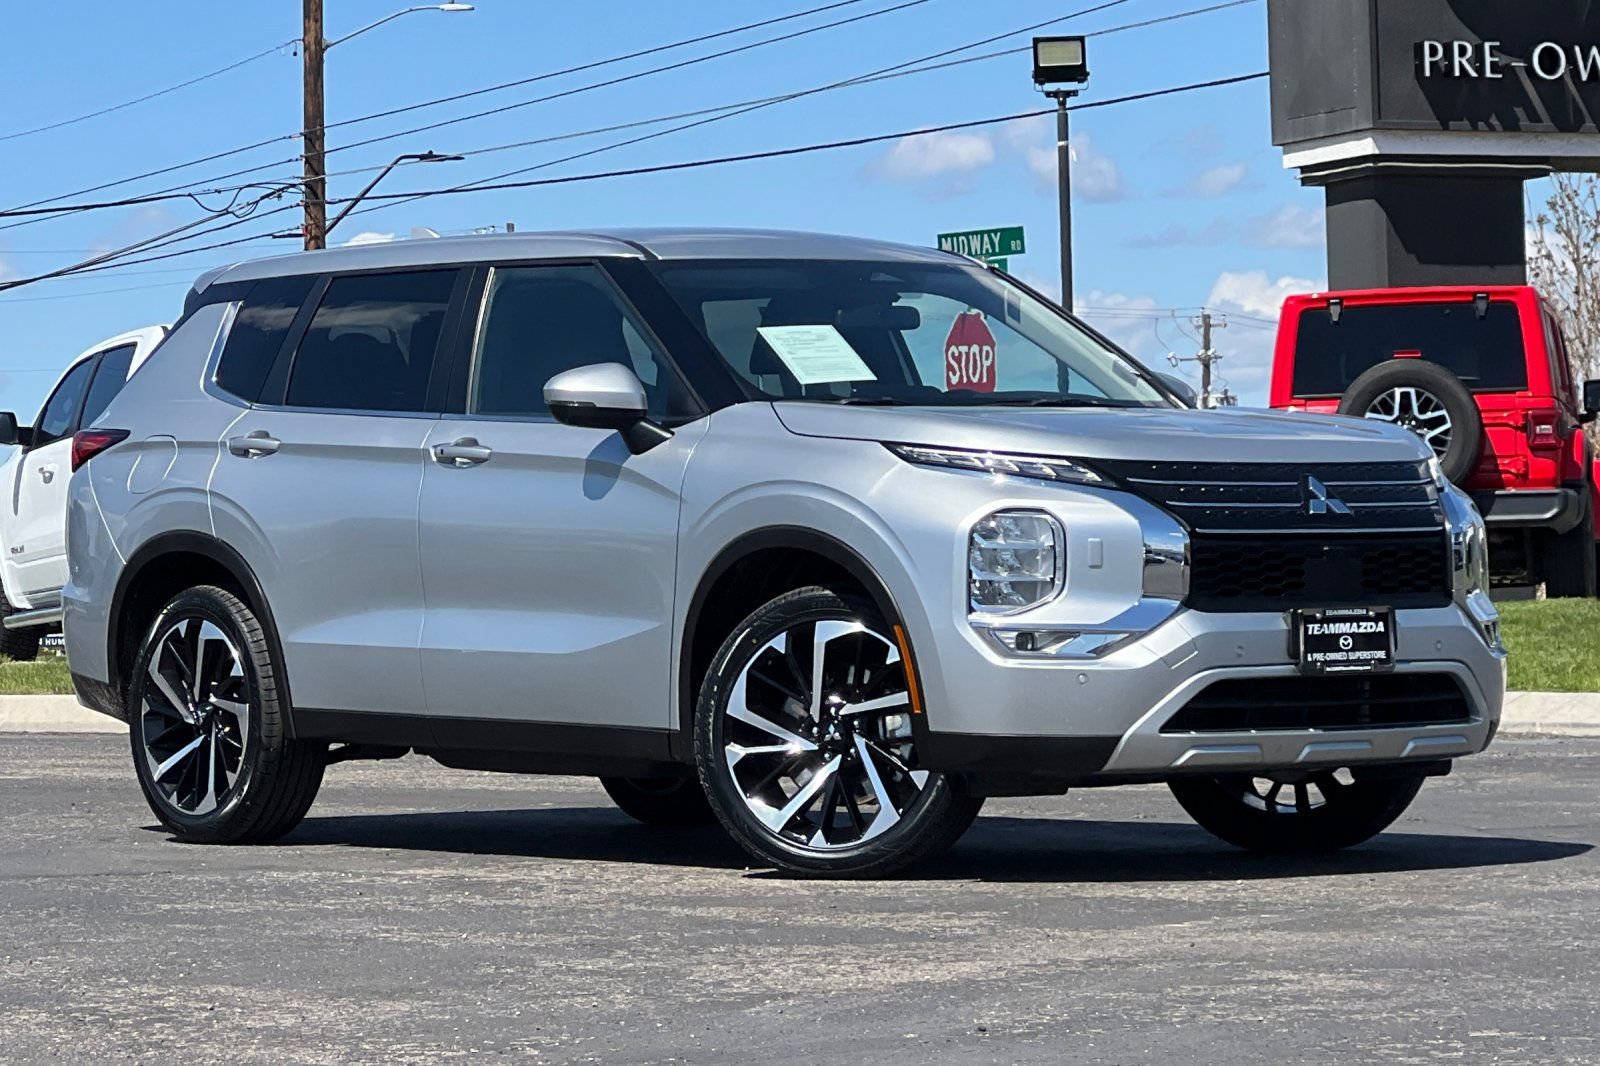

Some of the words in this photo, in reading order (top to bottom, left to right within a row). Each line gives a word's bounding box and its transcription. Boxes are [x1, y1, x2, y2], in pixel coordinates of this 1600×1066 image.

[941, 232, 1001, 255] MIDWAY
[1010, 239, 1022, 251] RD
[947, 344, 993, 385] STOP
[1306, 621, 1385, 635] TEAMMAZDA
[1312, 651, 1348, 662] PRE-OWNED
[1348, 650, 1387, 660] SUPERSTORE
